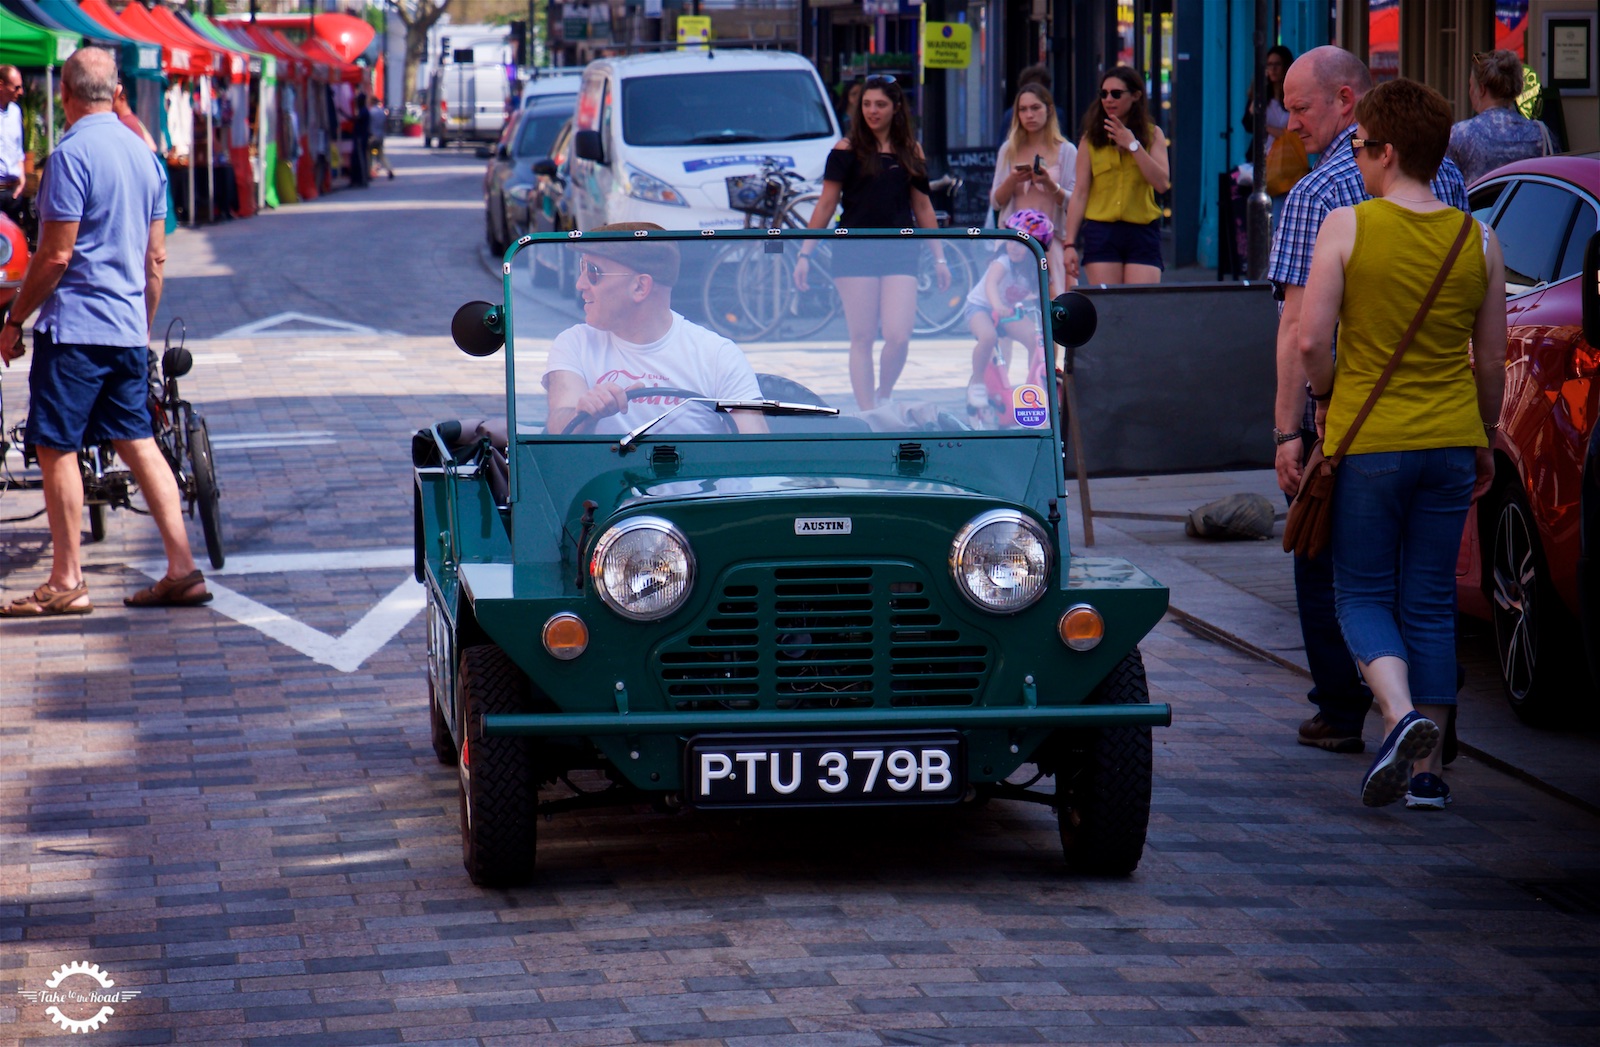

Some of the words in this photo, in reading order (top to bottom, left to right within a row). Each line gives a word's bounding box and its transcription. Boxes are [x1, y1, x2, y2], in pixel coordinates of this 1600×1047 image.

[927, 41, 967, 50] WARNING
[745, 155, 790, 164] Shp
[802, 521, 844, 530] AUSTIN
[701, 752, 801, 795] PTU
[818, 749, 952, 793] 379B
